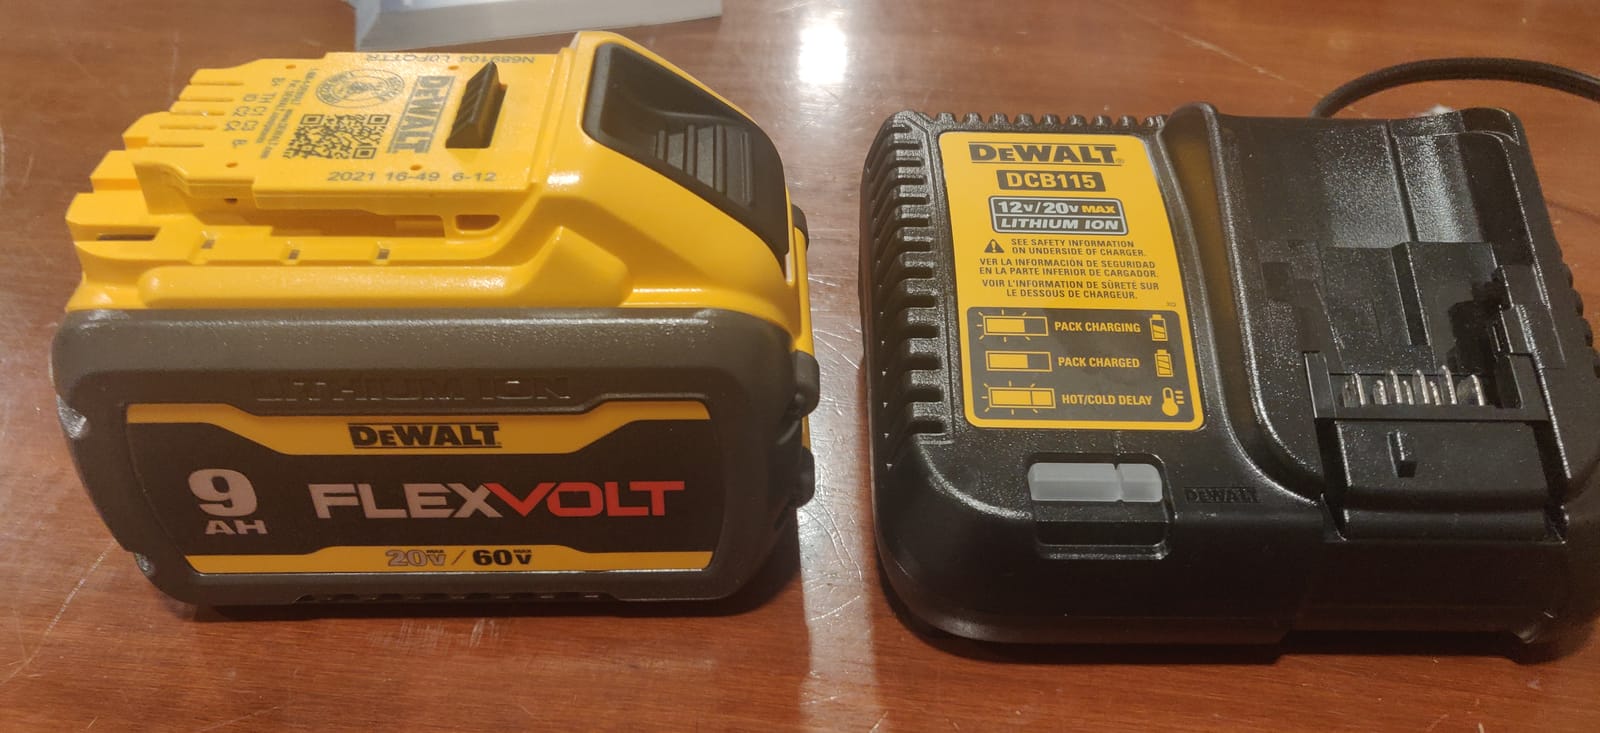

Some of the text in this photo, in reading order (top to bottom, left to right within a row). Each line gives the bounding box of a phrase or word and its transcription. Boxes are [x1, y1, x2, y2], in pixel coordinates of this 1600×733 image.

[232, 105, 250, 117] C2
[249, 105, 267, 116] C1
[386, 76, 455, 154] DEWALT
[327, 171, 497, 182] 2021 16-49 6-12
[1005, 172, 1097, 189] DCB115
[1081, 205, 1116, 214] MAX
[1000, 217, 1119, 230] LITHIUM ION
[1011, 238, 1134, 248] SEE SAFETY INFORMATION
[1029, 247, 1083, 255] UNDERSIDE
[1100, 248, 1147, 257] CHARGER.
[979, 258, 998, 266] VER
[1000, 258, 1013, 266] LA
[1015, 257, 1083, 267] INFORMACIÓN
[1101, 260, 1156, 269] SEGURIDAD
[979, 267, 1158, 278] EN LA PARTE INFERIOR DE CARGADOR.
[982, 279, 1159, 290] VOIR L'INFORMATION DE SÛRETÉ SUR
[1006, 289, 1138, 299] LE DESSOUS DE CHARGEUR.
[1054, 321, 1141, 333] PACK CHARGING
[1058, 356, 1140, 368] PACK CHARGED
[1061, 394, 1152, 405] HOT/COLD DELAY
[188, 469, 257, 517] 9
[309, 480, 686, 519] FLEXVOLT
[205, 519, 268, 535] AH
